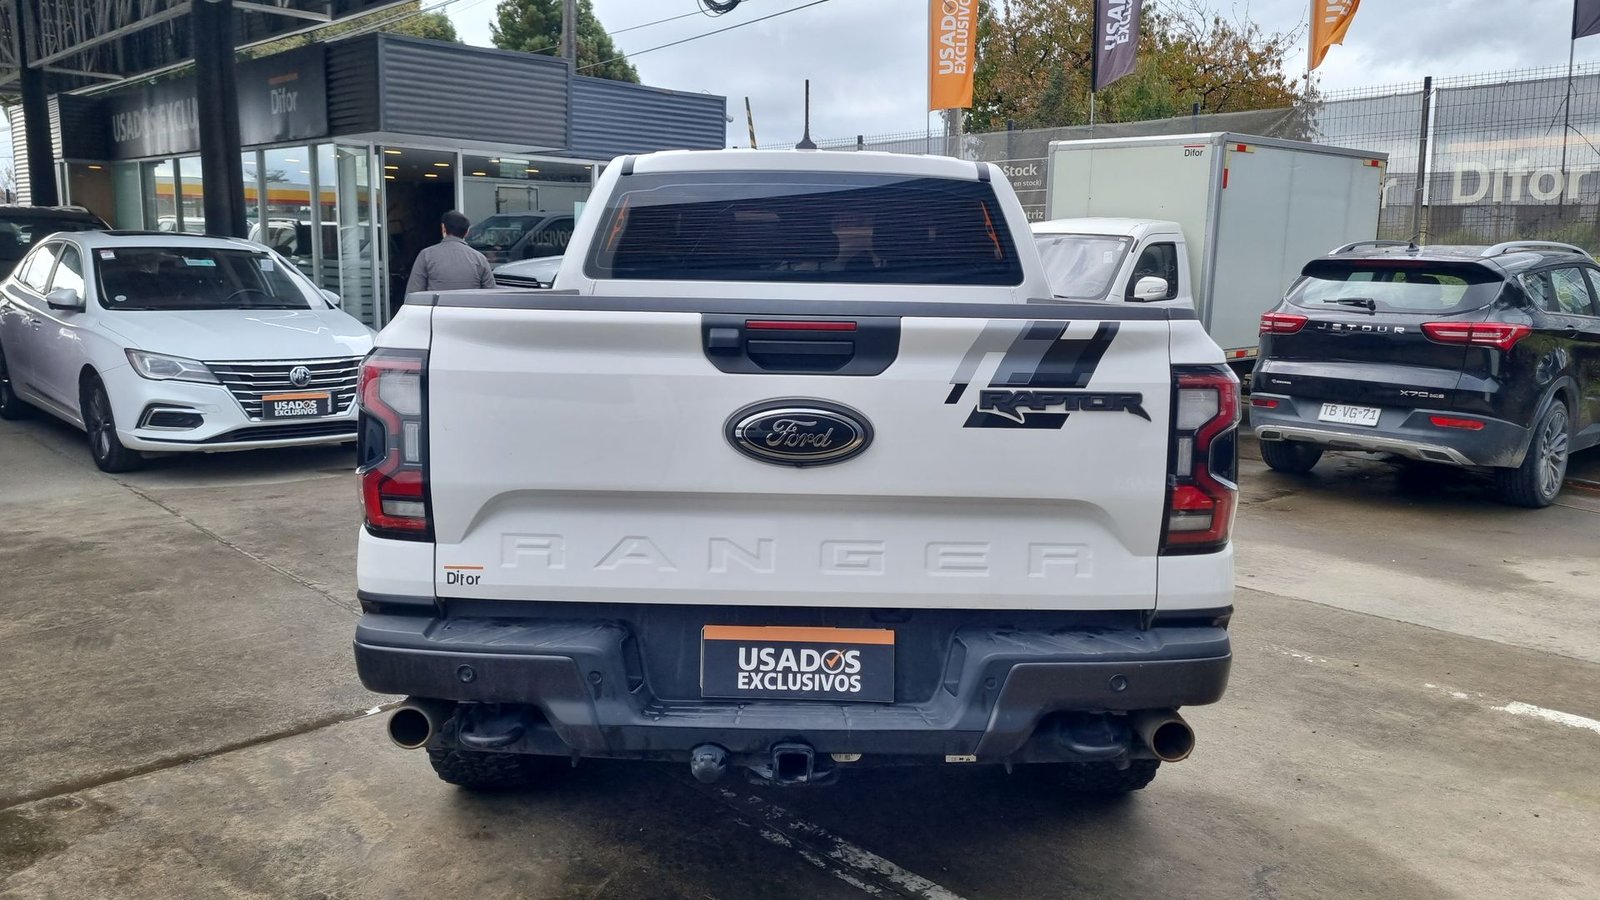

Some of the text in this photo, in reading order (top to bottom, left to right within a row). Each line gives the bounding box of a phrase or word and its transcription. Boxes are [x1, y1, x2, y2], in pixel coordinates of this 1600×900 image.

[954, 0, 971, 74] EXCLUSIVO
[1104, 0, 1126, 50] USA
[939, 0, 959, 75] USADO
[271, 87, 298, 115] Difor
[1184, 149, 1204, 157] Difor
[1003, 163, 1037, 177] Stock
[1452, 158, 1592, 204] Difor
[1024, 209, 1044, 220] triz
[1317, 322, 1406, 334] JETOUR
[274, 400, 318, 410] USADOS
[979, 389, 1152, 422] RAPTOR
[1400, 389, 1429, 398] X70
[274, 408, 318, 417] EXCLUSIVOS
[765, 418, 835, 448] Ford
[500, 532, 1094, 580] RANGER
[446, 569, 481, 586] Difor
[738, 646, 861, 674] USADOS
[737, 672, 861, 693] EXCLUSIVOS
